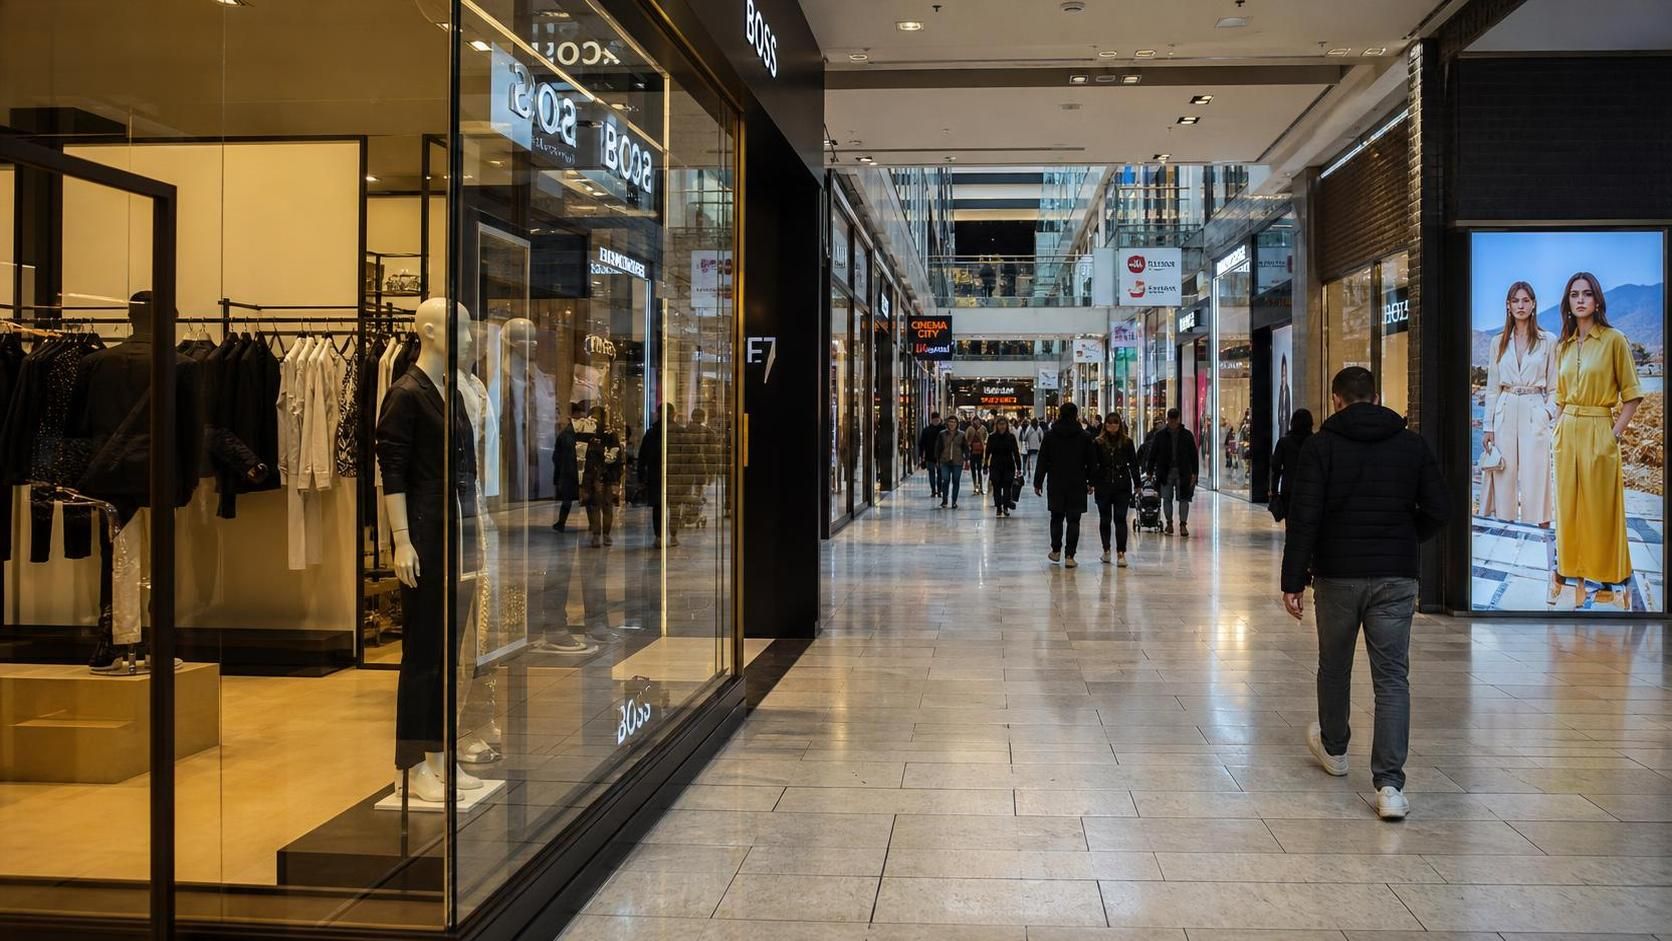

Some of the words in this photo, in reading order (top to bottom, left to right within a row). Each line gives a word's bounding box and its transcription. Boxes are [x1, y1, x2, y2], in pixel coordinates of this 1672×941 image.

[746, 0, 777, 78] BOSS
[911, 320, 948, 330] CINEMA
[917, 329, 939, 338] CITY
